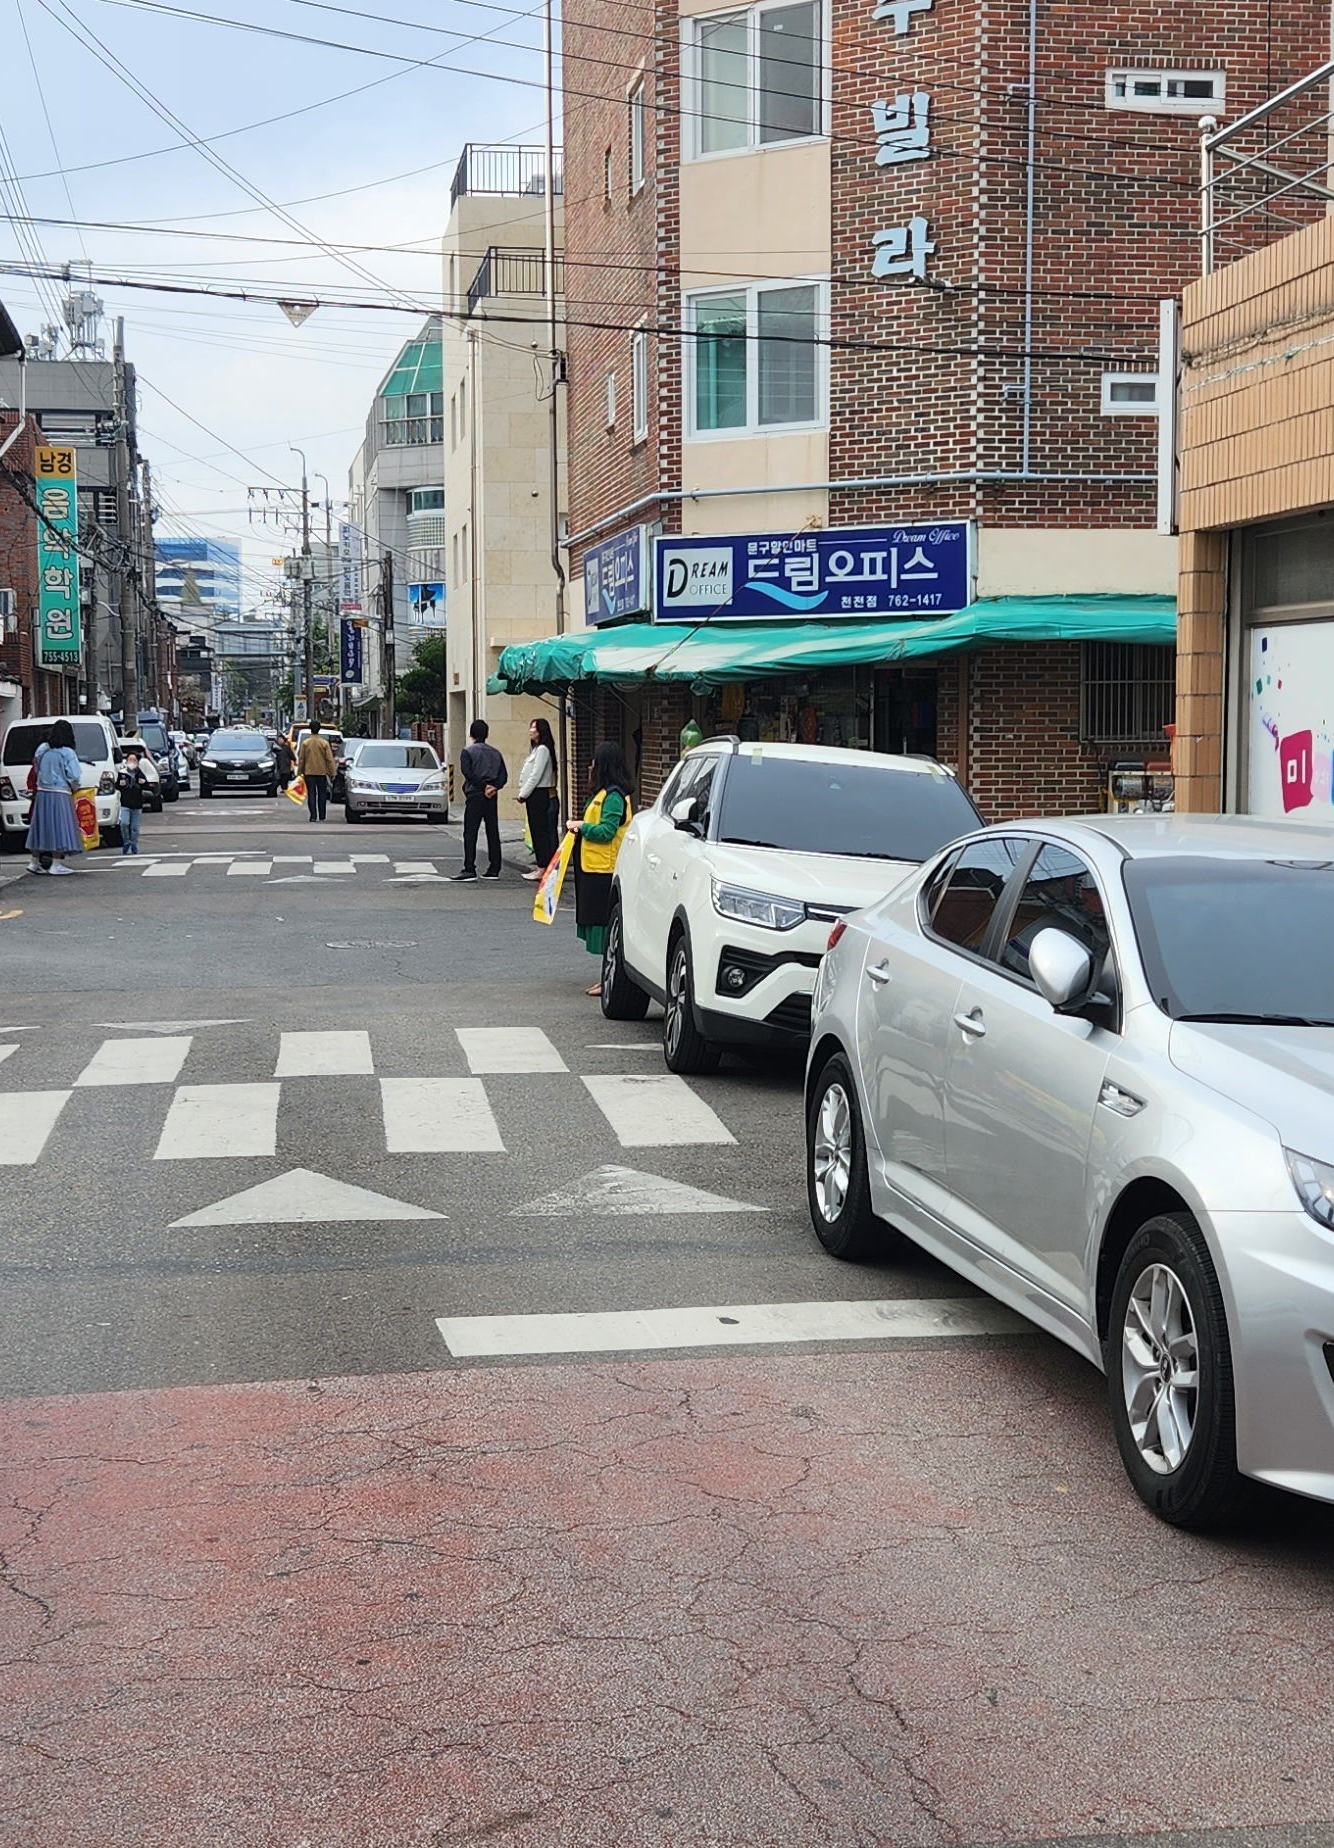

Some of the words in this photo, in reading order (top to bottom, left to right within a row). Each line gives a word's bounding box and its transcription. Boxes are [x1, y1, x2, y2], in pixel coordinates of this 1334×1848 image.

[39, 452, 72, 473] 남경
[892, 528, 927, 544] Dream
[928, 527, 961, 545] Office
[666, 558, 729, 598] DREAM
[747, 546, 939, 592] 드림오피스
[689, 583, 728, 596] OFFICE
[840, 595, 877, 608] 천전점
[887, 593, 943, 607] 762-1417
[43, 650, 79, 664] 755-4513
